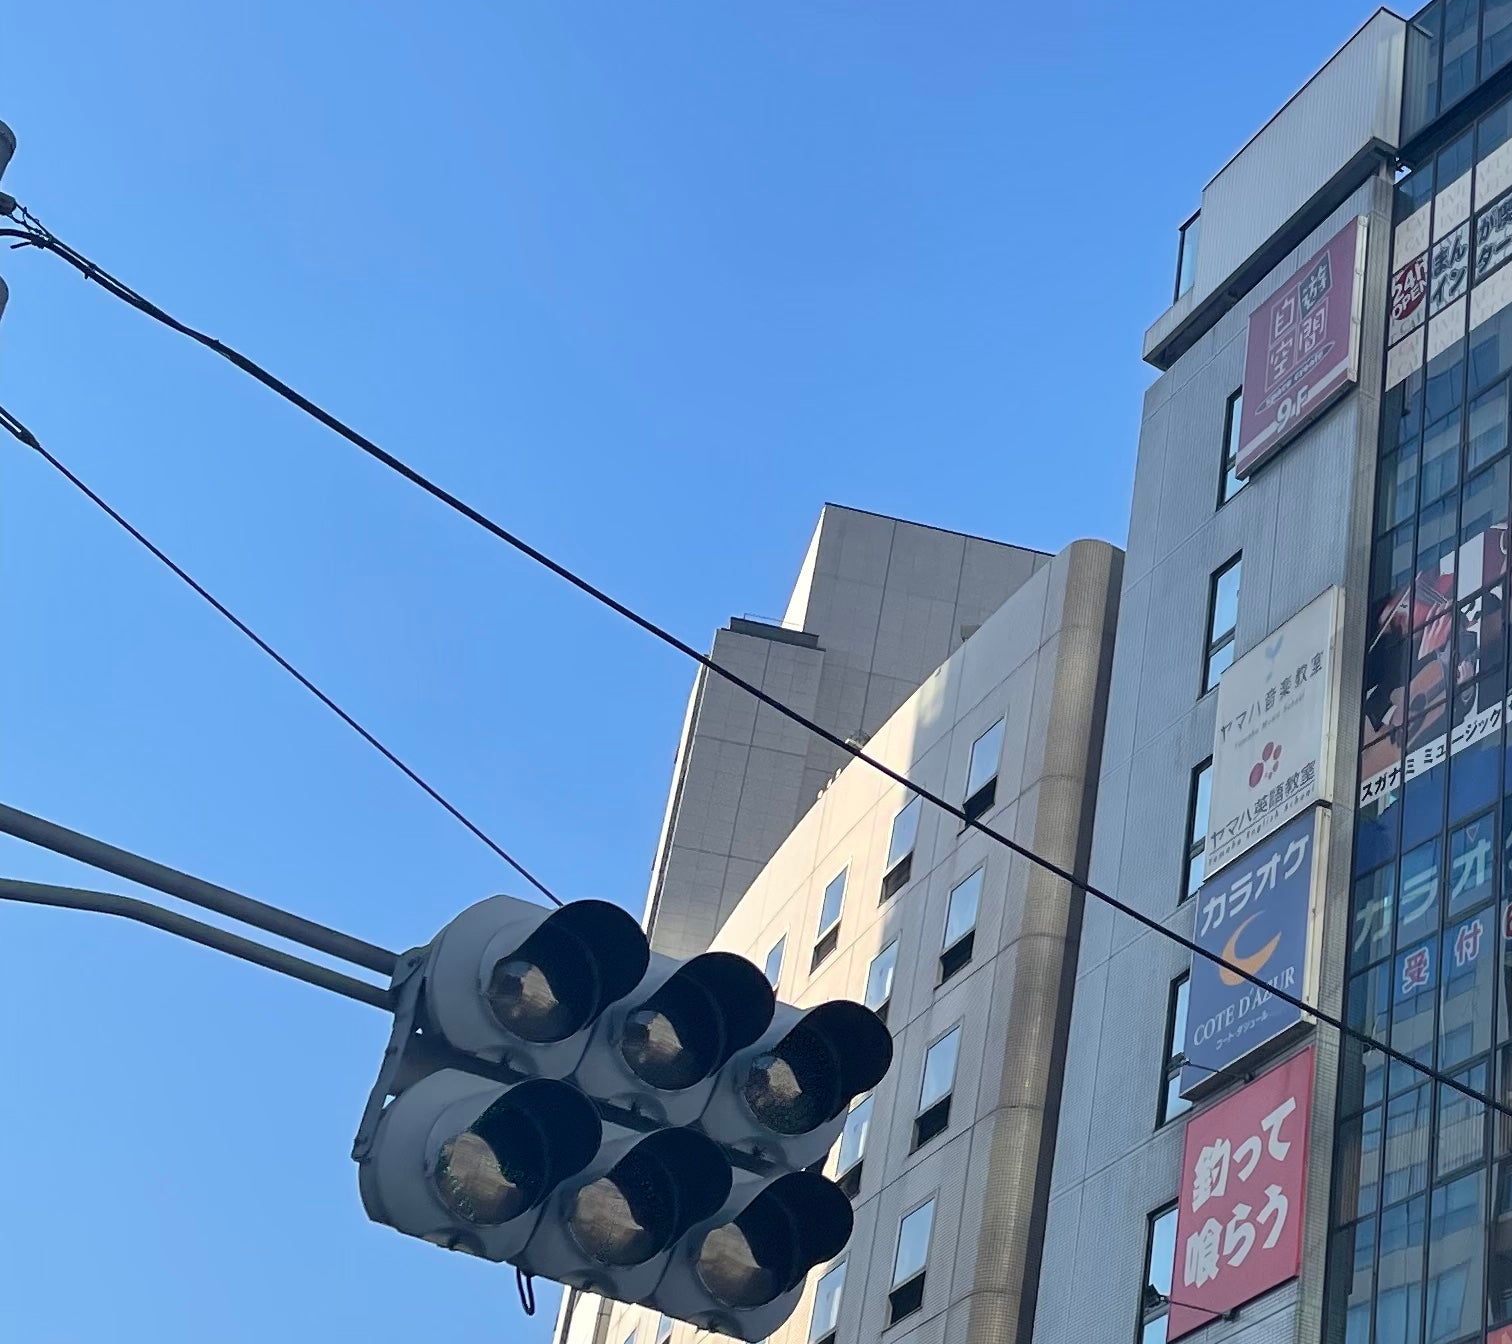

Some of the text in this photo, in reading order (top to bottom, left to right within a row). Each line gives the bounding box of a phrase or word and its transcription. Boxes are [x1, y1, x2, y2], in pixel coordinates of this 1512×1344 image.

[1391, 278, 1428, 319] OPEN
[1276, 383, 1310, 434] 9F
[1221, 650, 1324, 743] ヤマハ音楽教室
[1211, 760, 1316, 849] ヤマハ英語教室
[1201, 834, 1309, 937] カラオケ
[1402, 919, 1483, 994] 受付
[1194, 1004, 1235, 1047] COTE
[1192, 1096, 1296, 1213] 釣って
[1184, 1183, 1289, 1289] 喰らう
